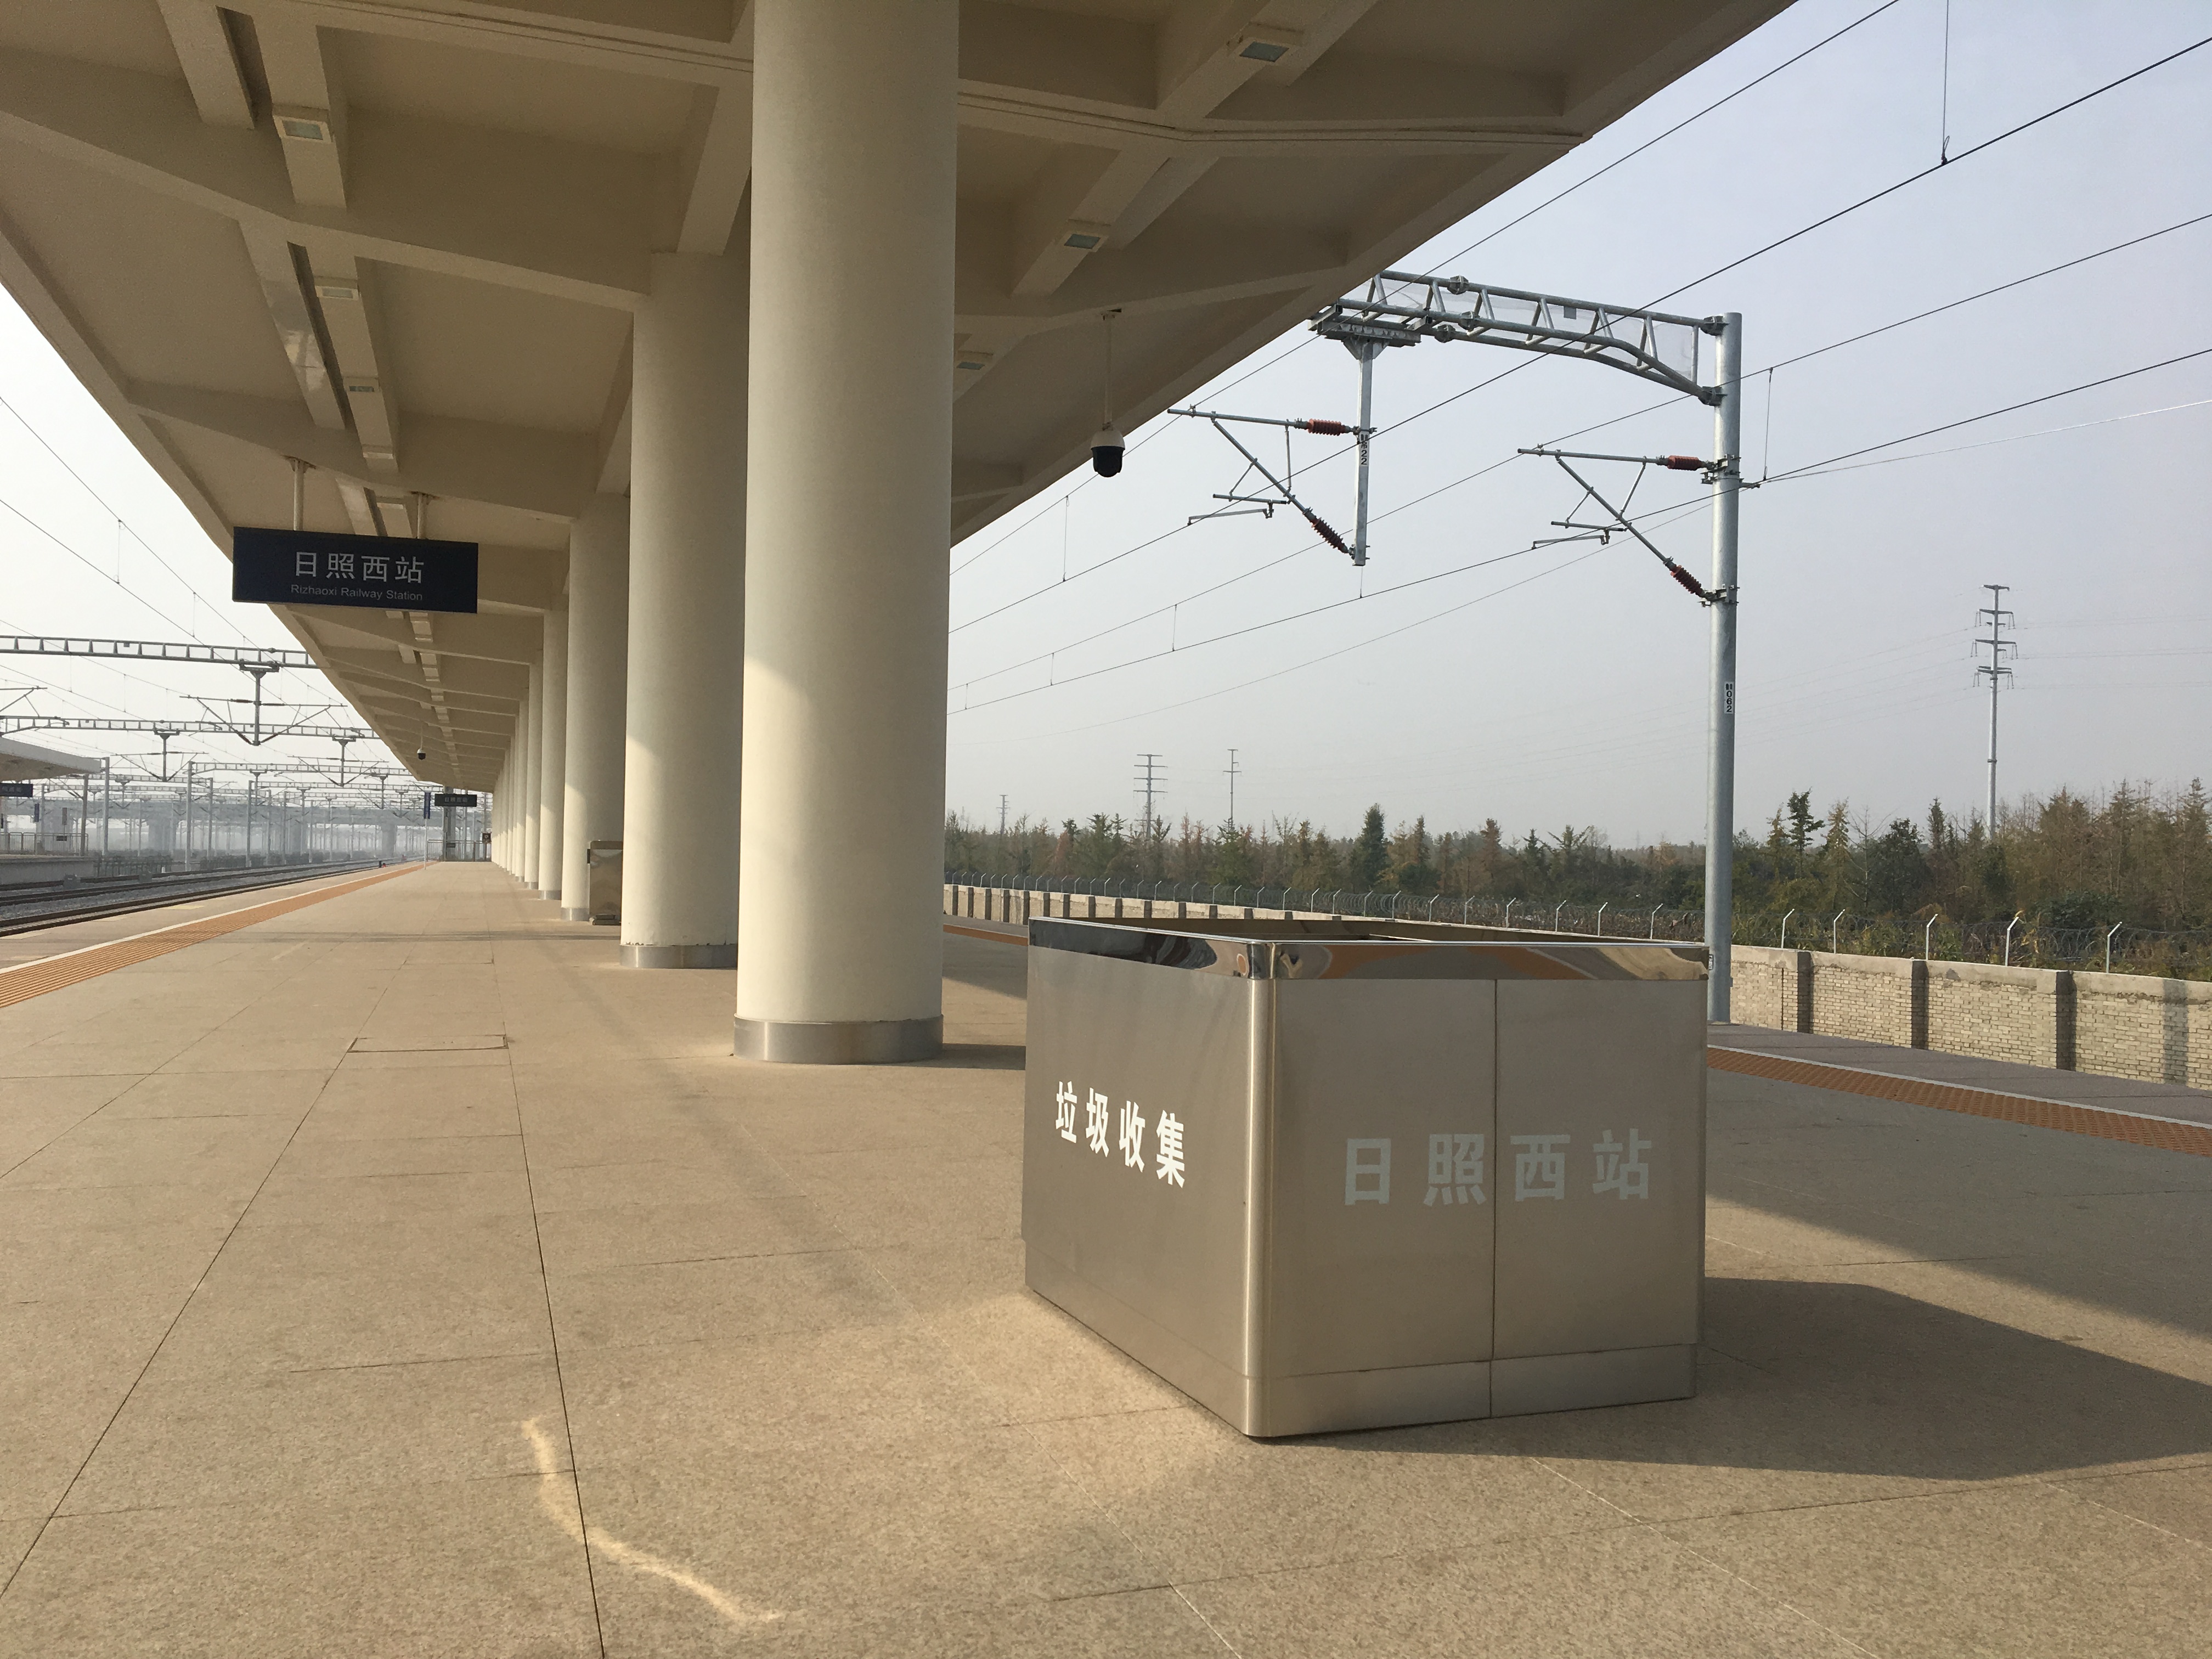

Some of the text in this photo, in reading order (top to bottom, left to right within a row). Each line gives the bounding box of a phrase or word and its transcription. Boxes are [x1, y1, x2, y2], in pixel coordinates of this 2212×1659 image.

[291, 584, 422, 601] Rizhaoxi Railway Station
[295, 551, 424, 584] 日照西站
[1055, 1081, 1185, 1188] 垃圾收集
[1345, 1128, 1652, 1206] 日照西站
